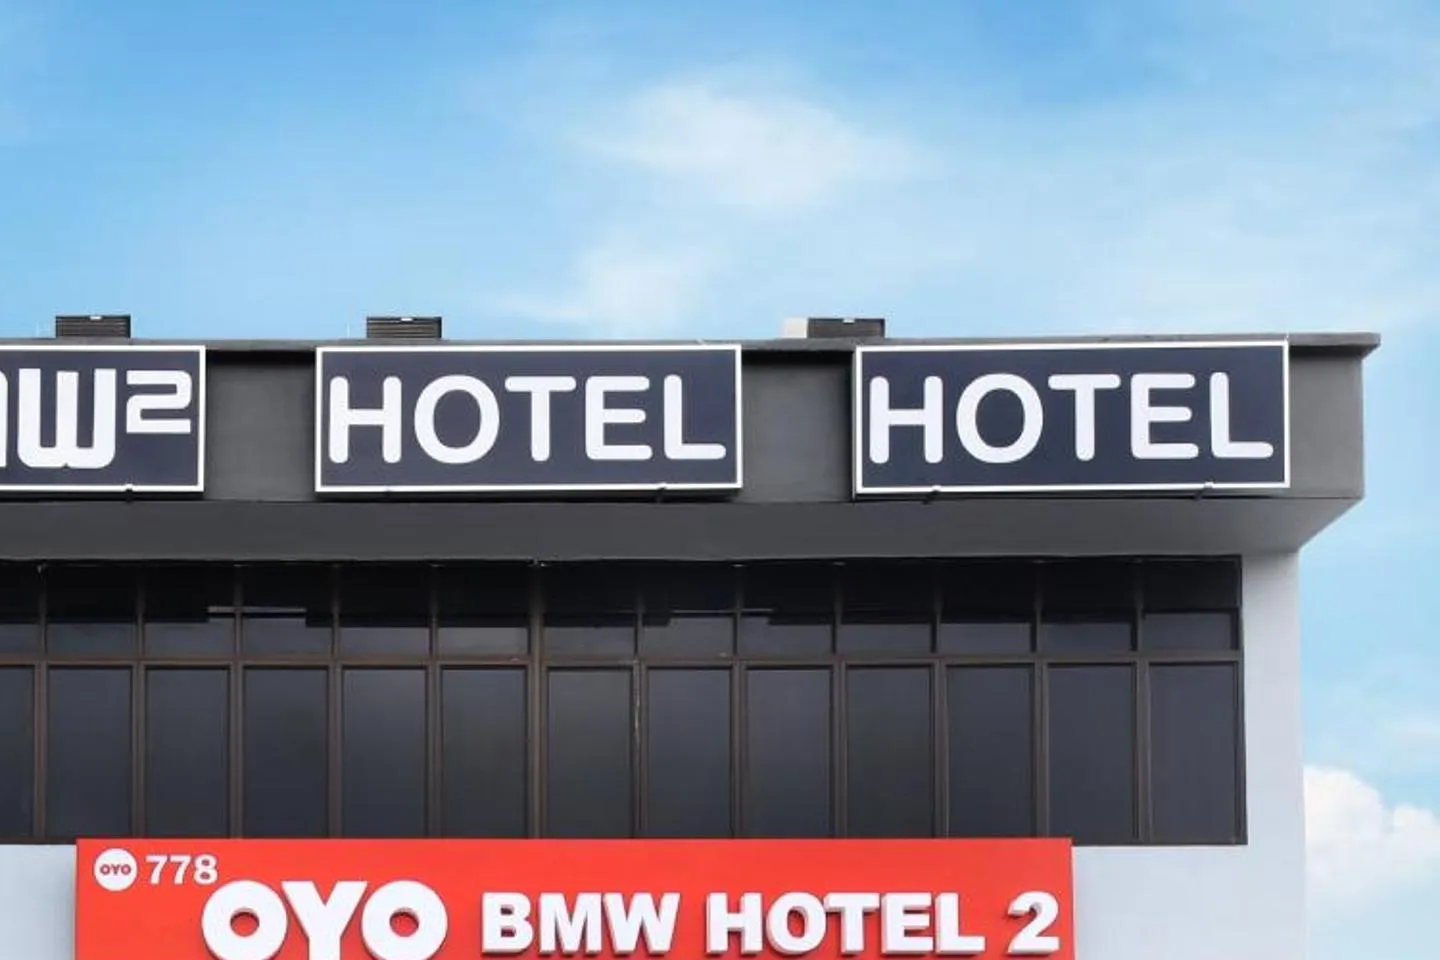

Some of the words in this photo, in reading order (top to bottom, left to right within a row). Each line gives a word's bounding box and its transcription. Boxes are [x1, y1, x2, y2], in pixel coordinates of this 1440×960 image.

[328, 374, 727, 464] HOTEL
[869, 373, 1274, 464] HOTEL
[100, 864, 131, 875] OYO
[145, 854, 219, 885] 778
[481, 891, 682, 955] BMW
[705, 891, 987, 956] HOTEL
[1007, 891, 1061, 954] 2
